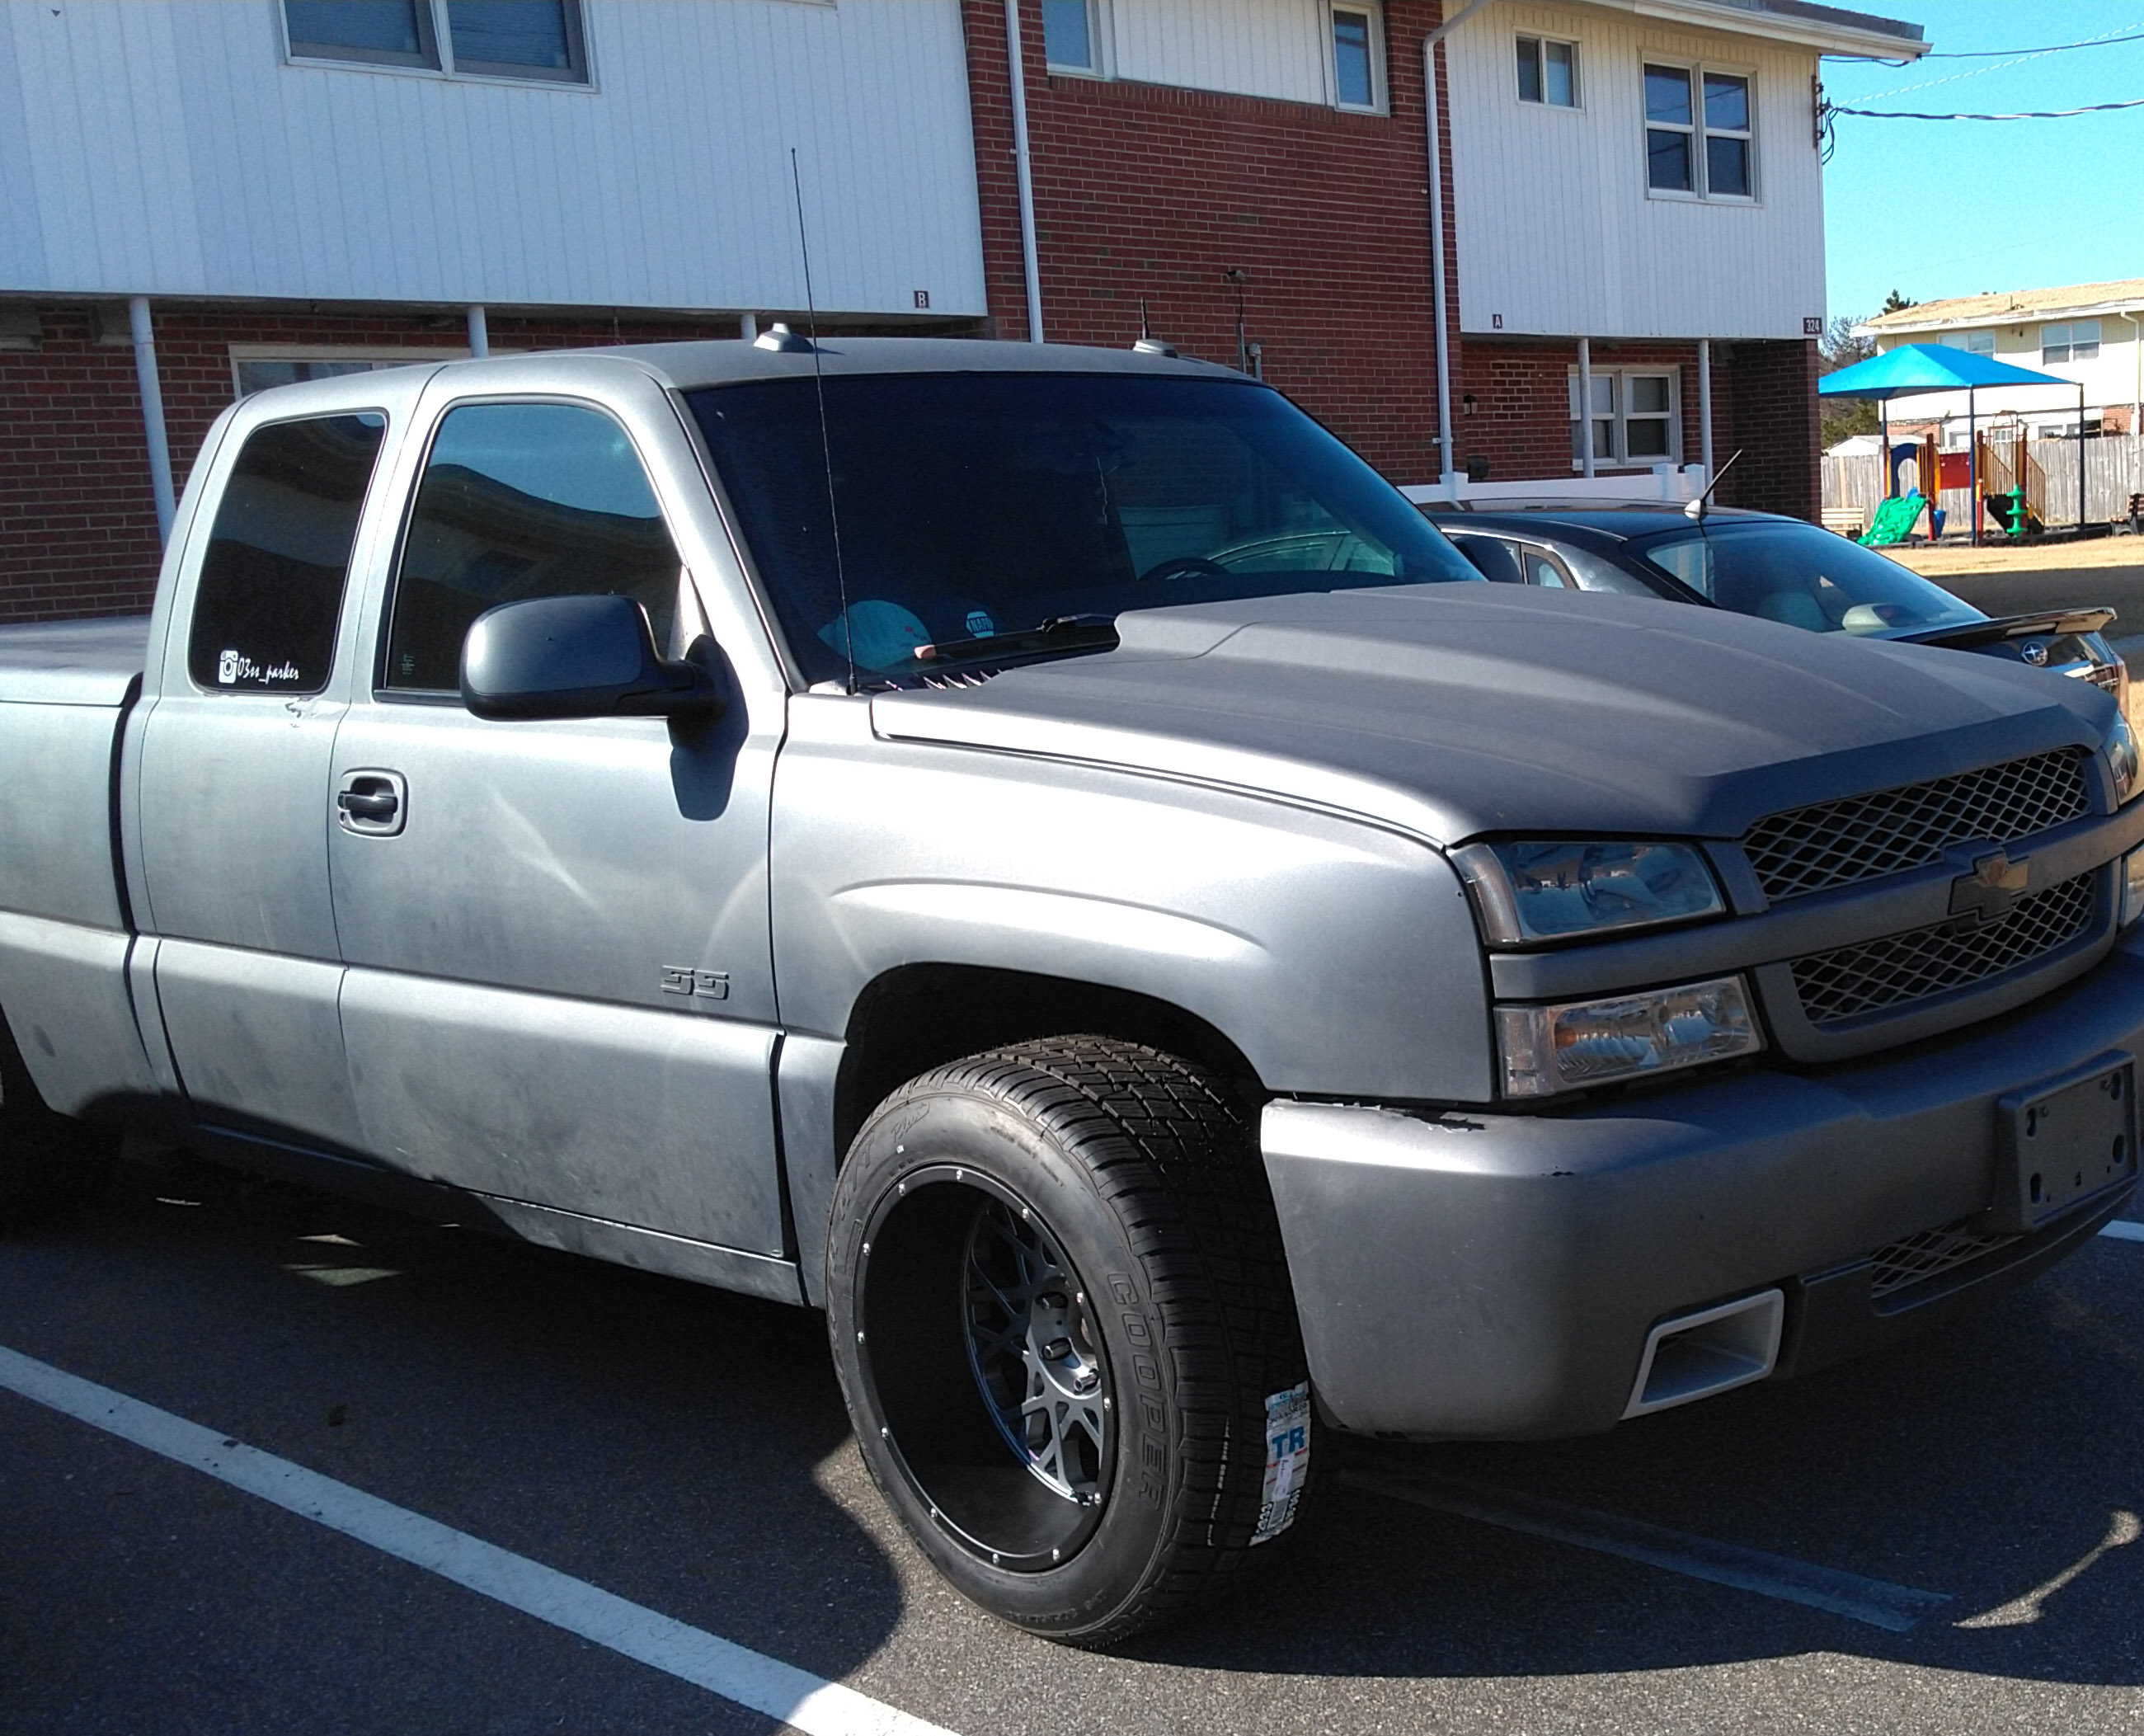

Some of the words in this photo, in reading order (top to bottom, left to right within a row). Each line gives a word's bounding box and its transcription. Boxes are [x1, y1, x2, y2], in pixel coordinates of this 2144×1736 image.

[918, 292, 926, 308] B
[1495, 315, 1502, 327] A
[1806, 319, 1820, 332] 324
[660, 965, 729, 1000] SS
[1107, 1273, 1166, 1511] COOPER
[1272, 1426, 1306, 1459] TR
